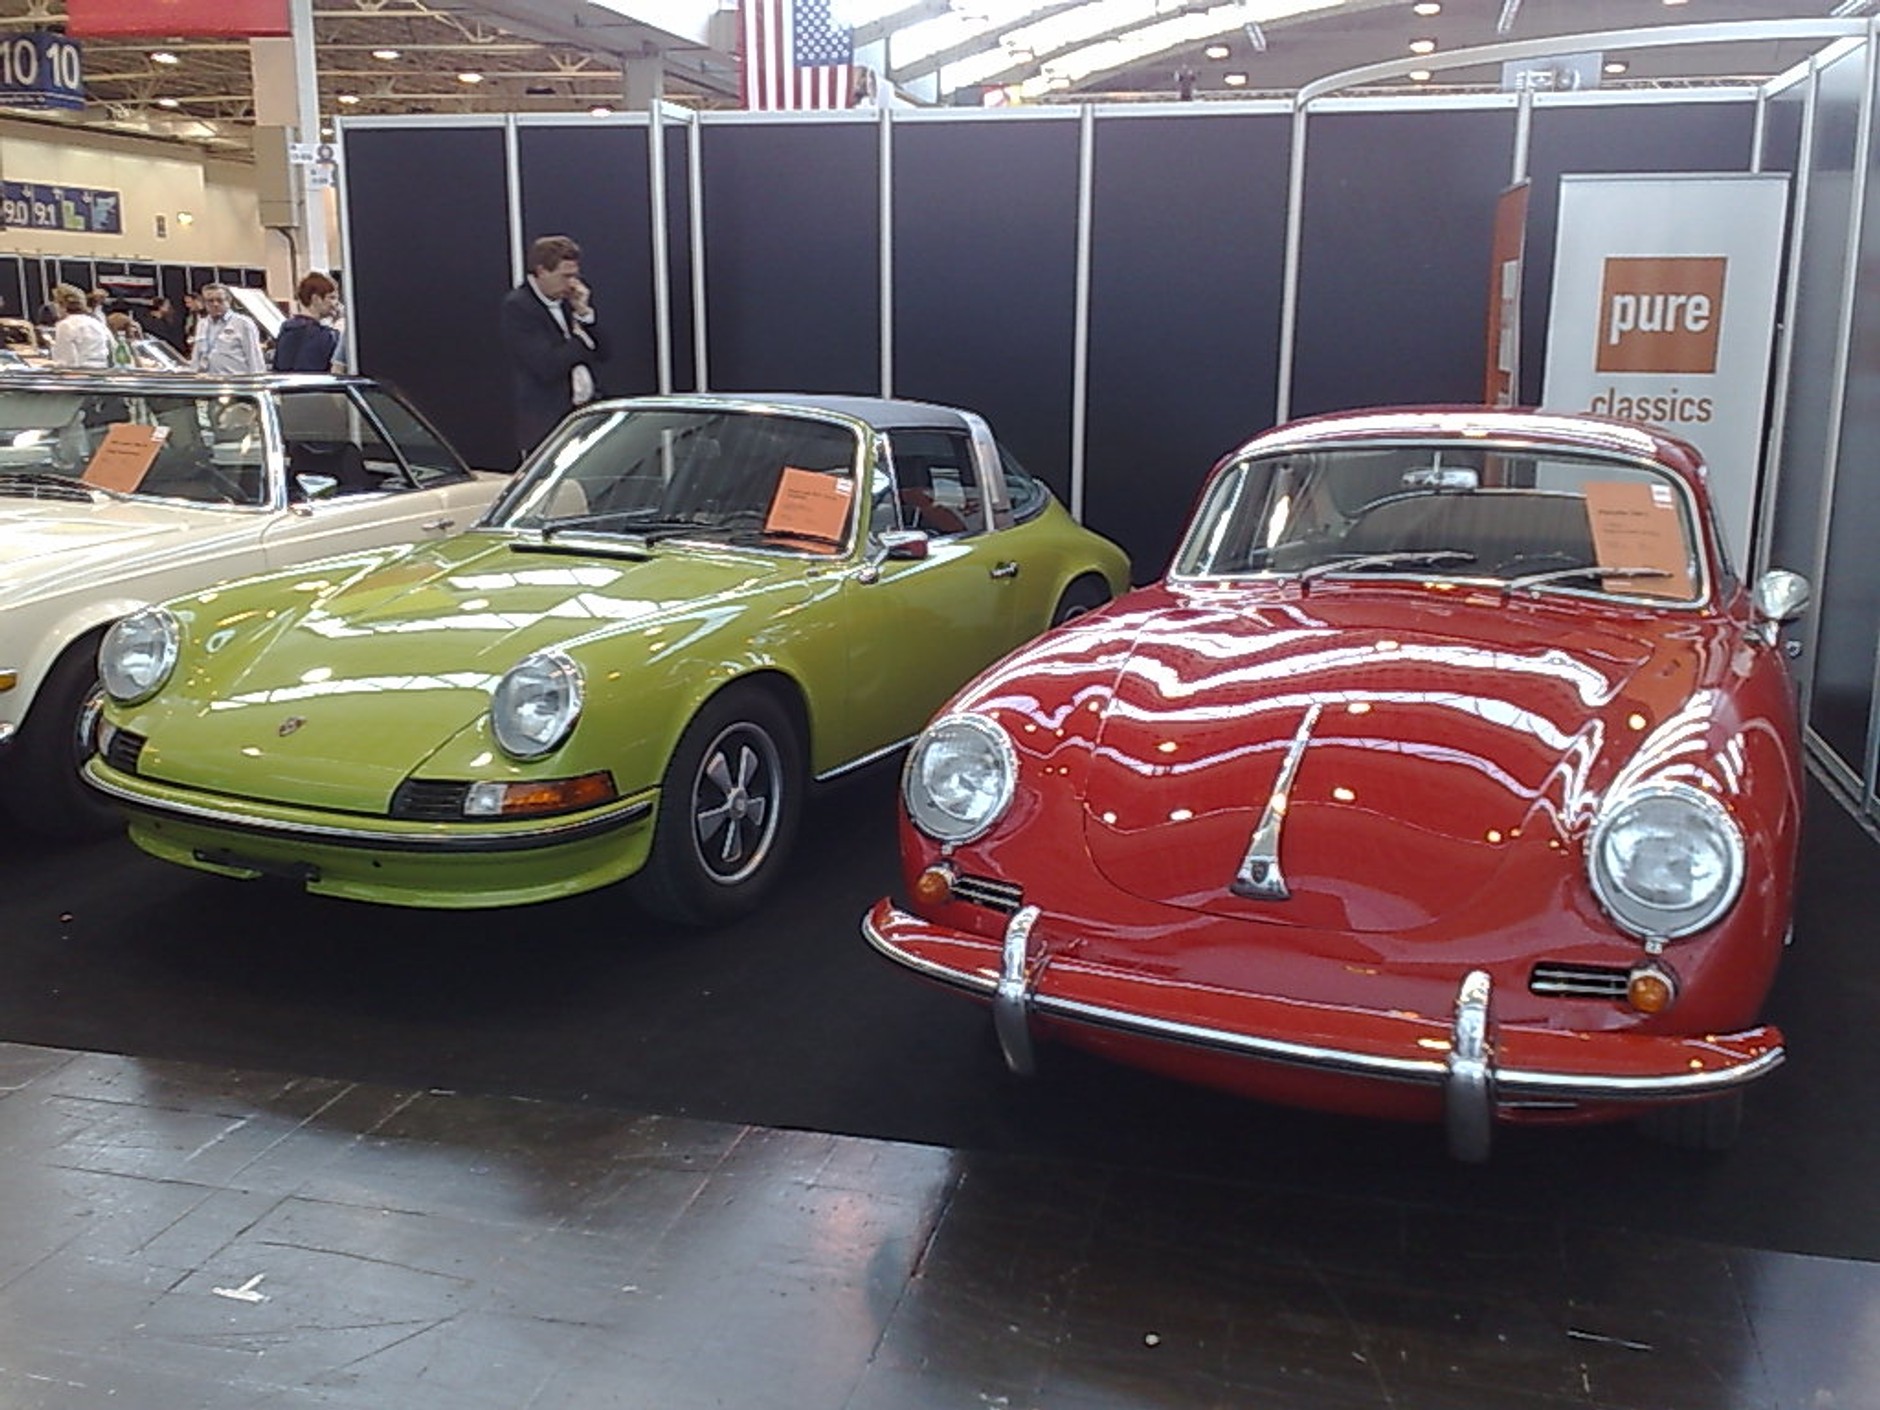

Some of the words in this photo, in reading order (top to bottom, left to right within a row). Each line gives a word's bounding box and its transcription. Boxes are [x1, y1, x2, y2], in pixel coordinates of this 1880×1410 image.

[0, 39, 38, 85] 10
[46, 43, 79, 90] 10
[1609, 293, 1711, 345] pure
[1591, 386, 1713, 422] classics
